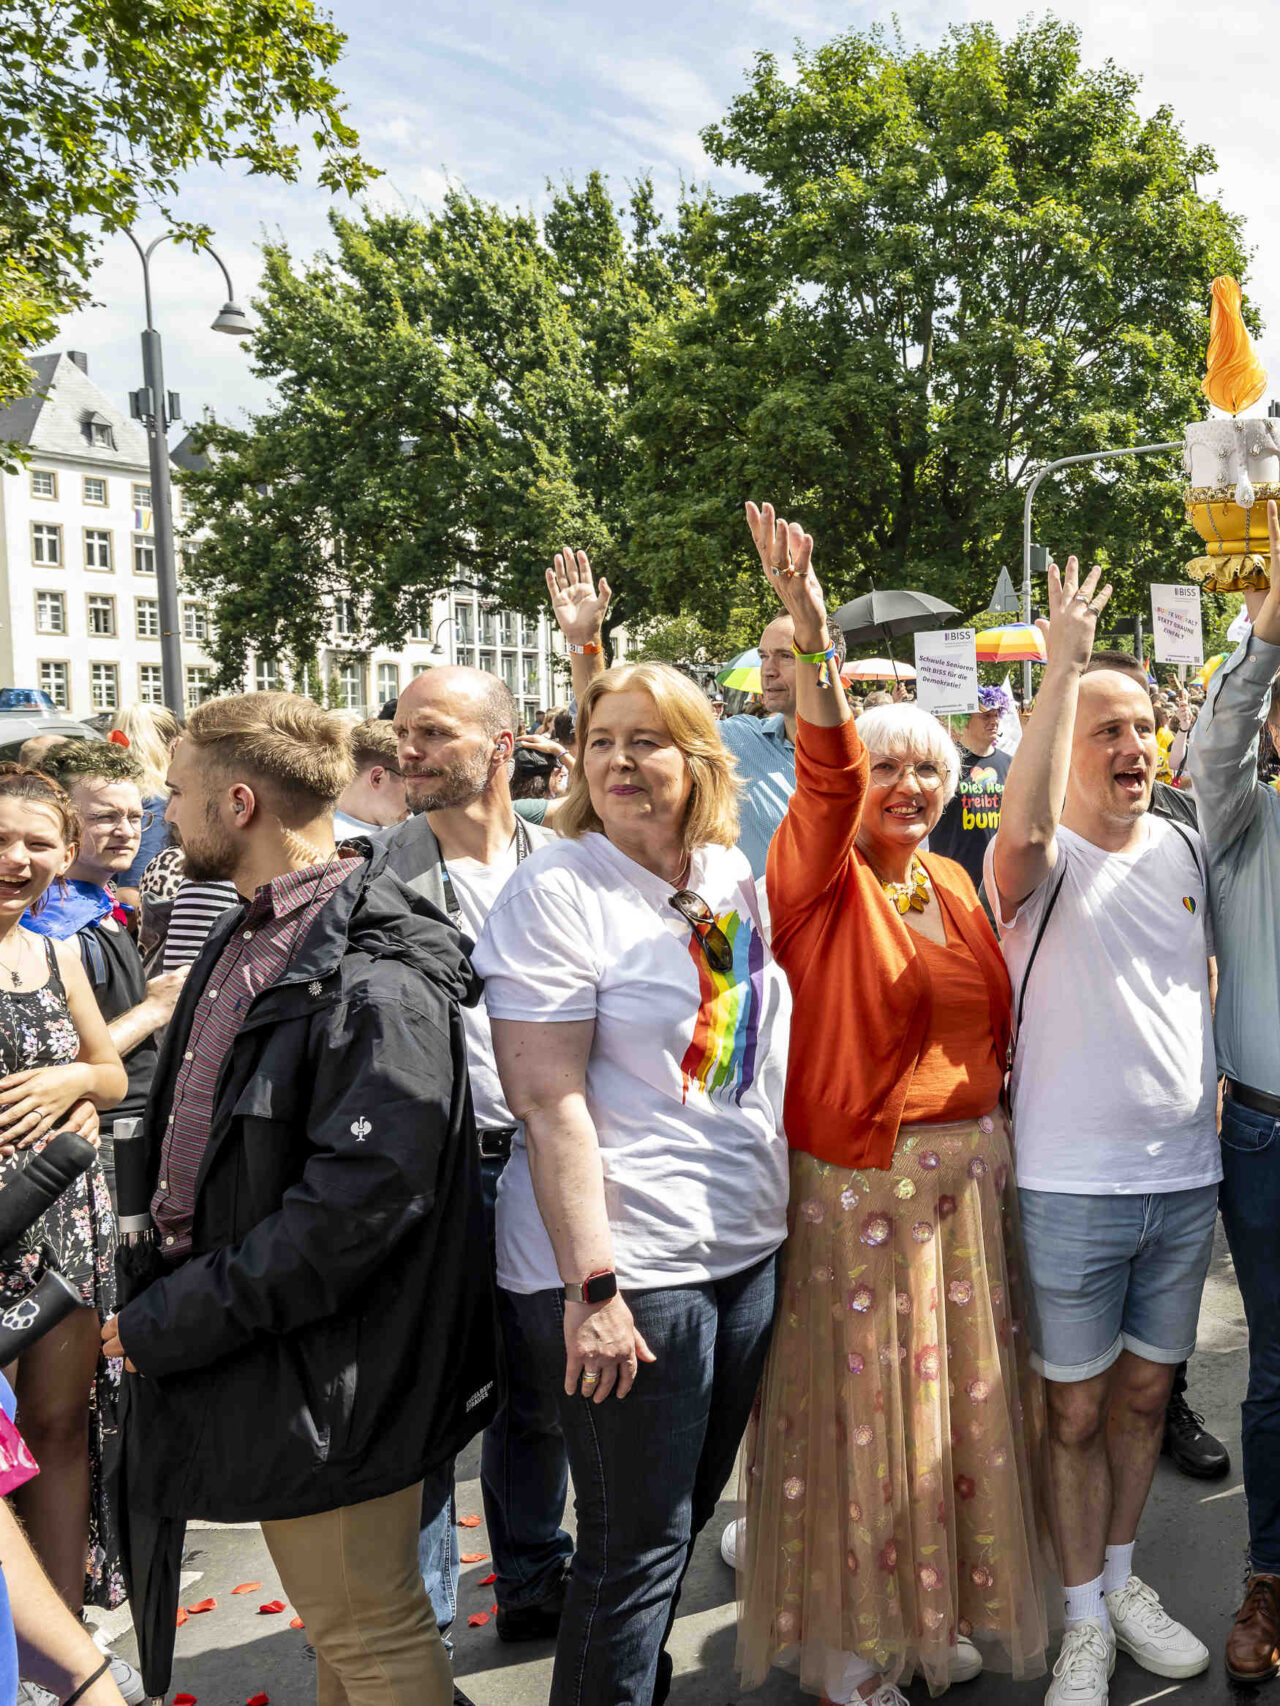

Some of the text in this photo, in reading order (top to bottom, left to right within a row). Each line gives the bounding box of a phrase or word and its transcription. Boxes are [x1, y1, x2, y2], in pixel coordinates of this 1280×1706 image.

[1179, 588, 1197, 597] BISS
[950, 631, 971, 641] BISS
[919, 655, 974, 672] Schwule Senioren
[920, 665, 968, 681] mit BISS für die
[922, 675, 962, 689] Demokratie!
[960, 781, 983, 794] Dies
[961, 794, 999, 809] treibt
